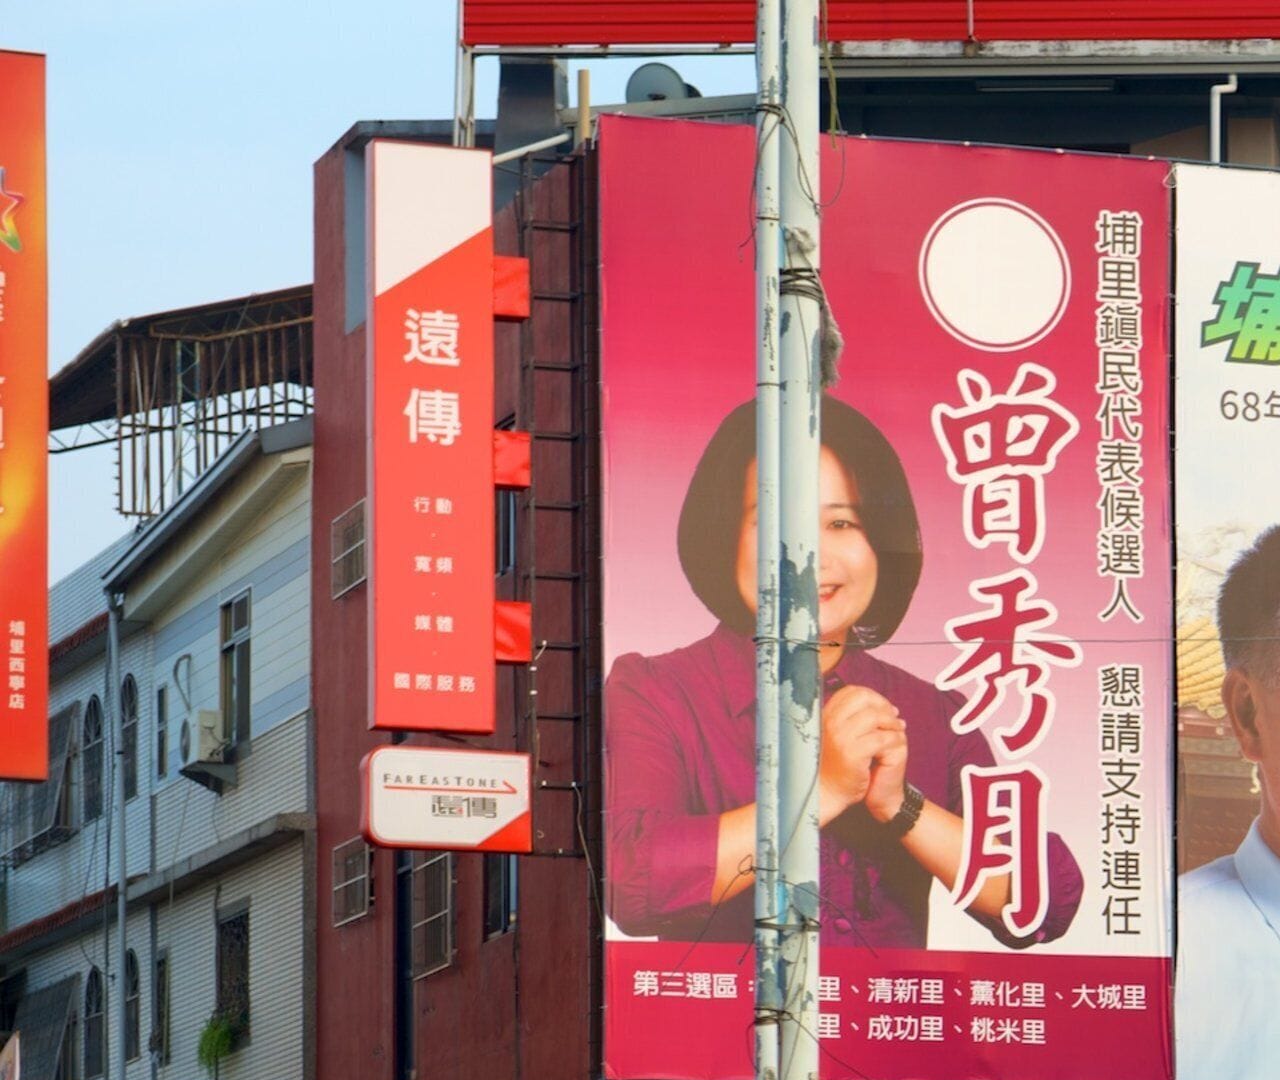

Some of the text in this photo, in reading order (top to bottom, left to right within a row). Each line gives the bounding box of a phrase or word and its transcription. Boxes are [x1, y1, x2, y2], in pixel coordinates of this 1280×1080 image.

[403, 308, 461, 446] 遠傳
[413, 496, 453, 515] 行動
[414, 555, 453, 574] 寬頻
[414, 615, 453, 634] 媒體
[931, 361, 1083, 938] 曾秀月
[393, 671, 477, 694] 國際服務
[431, 795, 498, 819] 遠傳
[1099, 663, 1142, 936] 懇請支持連任
